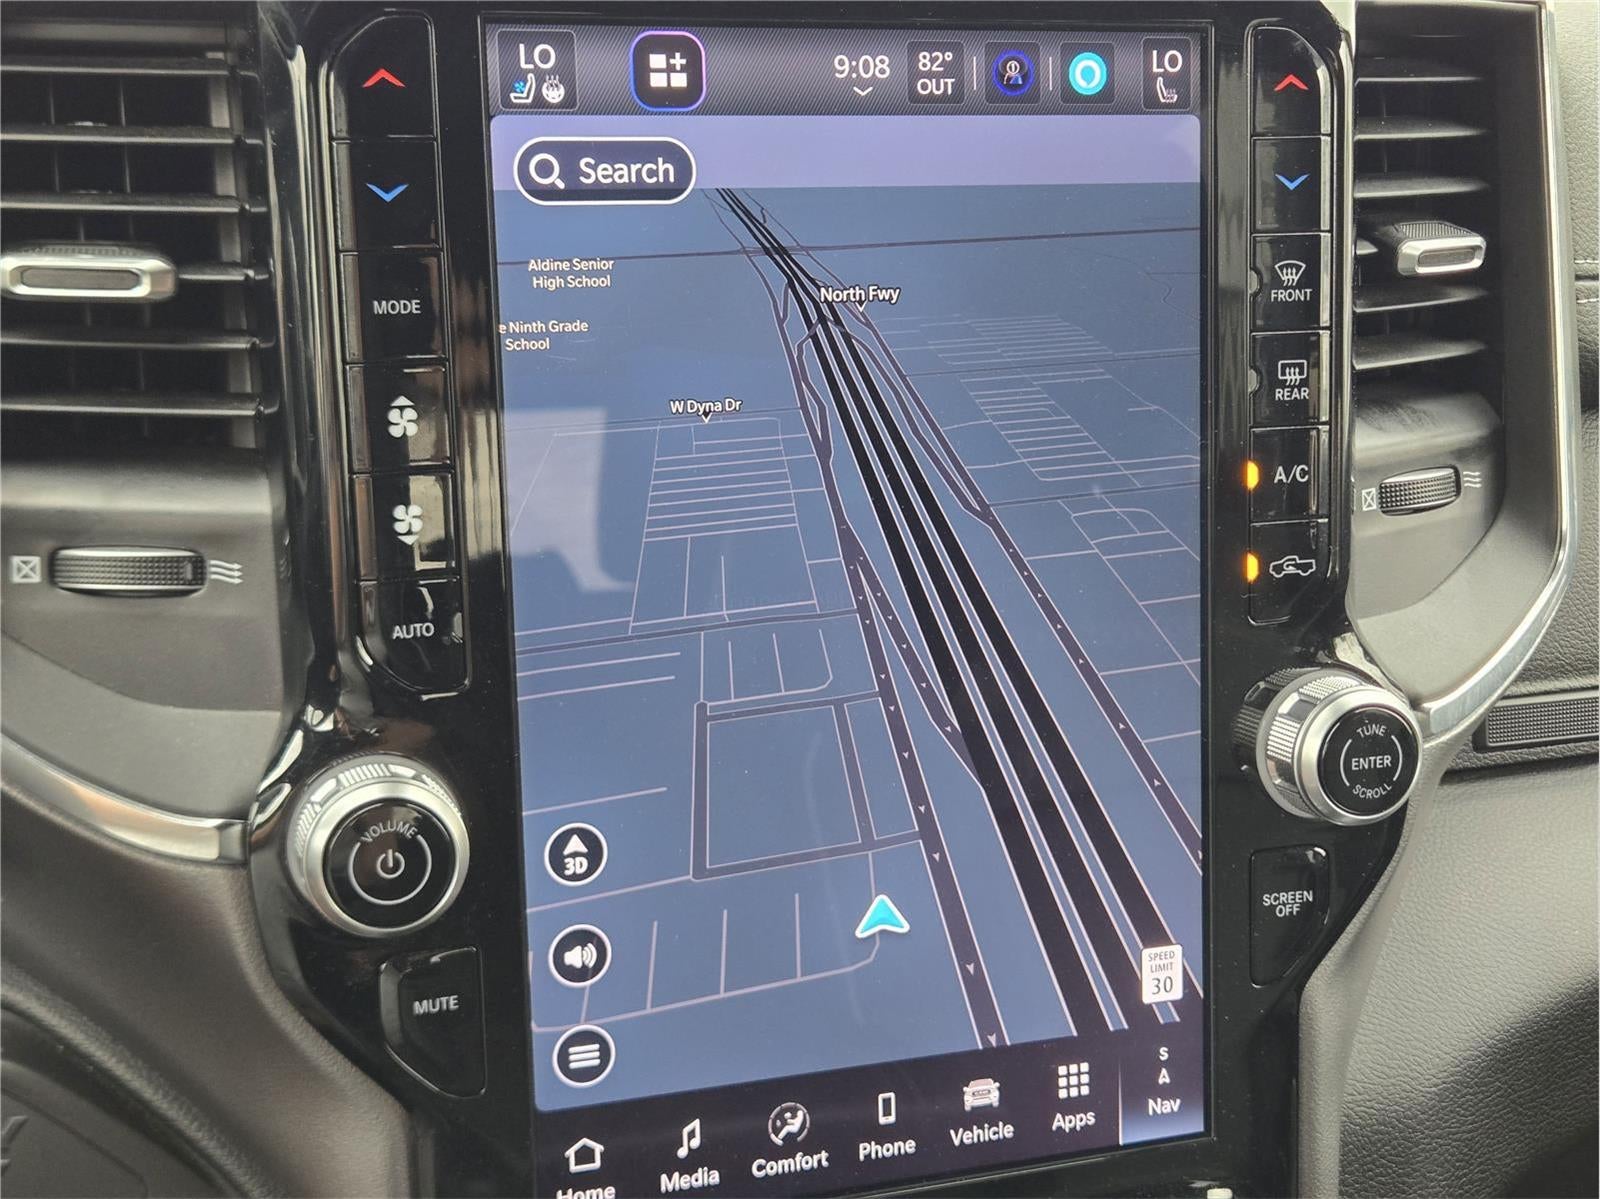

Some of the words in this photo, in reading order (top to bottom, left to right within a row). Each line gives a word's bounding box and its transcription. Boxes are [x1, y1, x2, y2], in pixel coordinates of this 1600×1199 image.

[518, 44, 556, 70] LO
[917, 51, 954, 72] 82°
[1152, 49, 1182, 73] LO
[833, 55, 891, 80] 9:08
[917, 78, 955, 96] OUT
[579, 158, 675, 185] Search
[528, 259, 570, 272] Aldine
[572, 258, 614, 271] Senior
[533, 275, 564, 291] High
[567, 274, 611, 288] School
[820, 287, 865, 302] North
[868, 286, 900, 303] Fwy
[1271, 289, 1312, 302] FRONT
[373, 299, 421, 315] MODE
[509, 321, 546, 333] Ninth
[549, 320, 588, 333] Grade
[505, 337, 550, 351] School
[1275, 388, 1309, 401] REAR
[670, 401, 686, 414] W
[687, 399, 722, 416] Dyna
[725, 398, 742, 412] Dr
[1274, 464, 1309, 483] A/C
[393, 622, 434, 639] AUTO
[1357, 722, 1387, 739] TUNE
[1351, 755, 1392, 771] ENTER
[1353, 782, 1392, 800] SCROLL
[360, 820, 418, 843] VOLUME
[564, 856, 588, 876] 3D
[1262, 890, 1313, 906] SCREEN
[1276, 904, 1300, 917] OFF
[1148, 950, 1175, 962] SPEED
[1150, 961, 1174, 974] LIMIT
[1152, 976, 1173, 995] 30
[413, 994, 459, 1015] MUTE
[1148, 1098, 1181, 1116] Nav
[1051, 1108, 1096, 1134] Apps
[949, 1119, 1015, 1148] Vehicle
[858, 1136, 916, 1162] Phone
[751, 1150, 829, 1178] Comfort
[660, 1167, 720, 1194] Media
